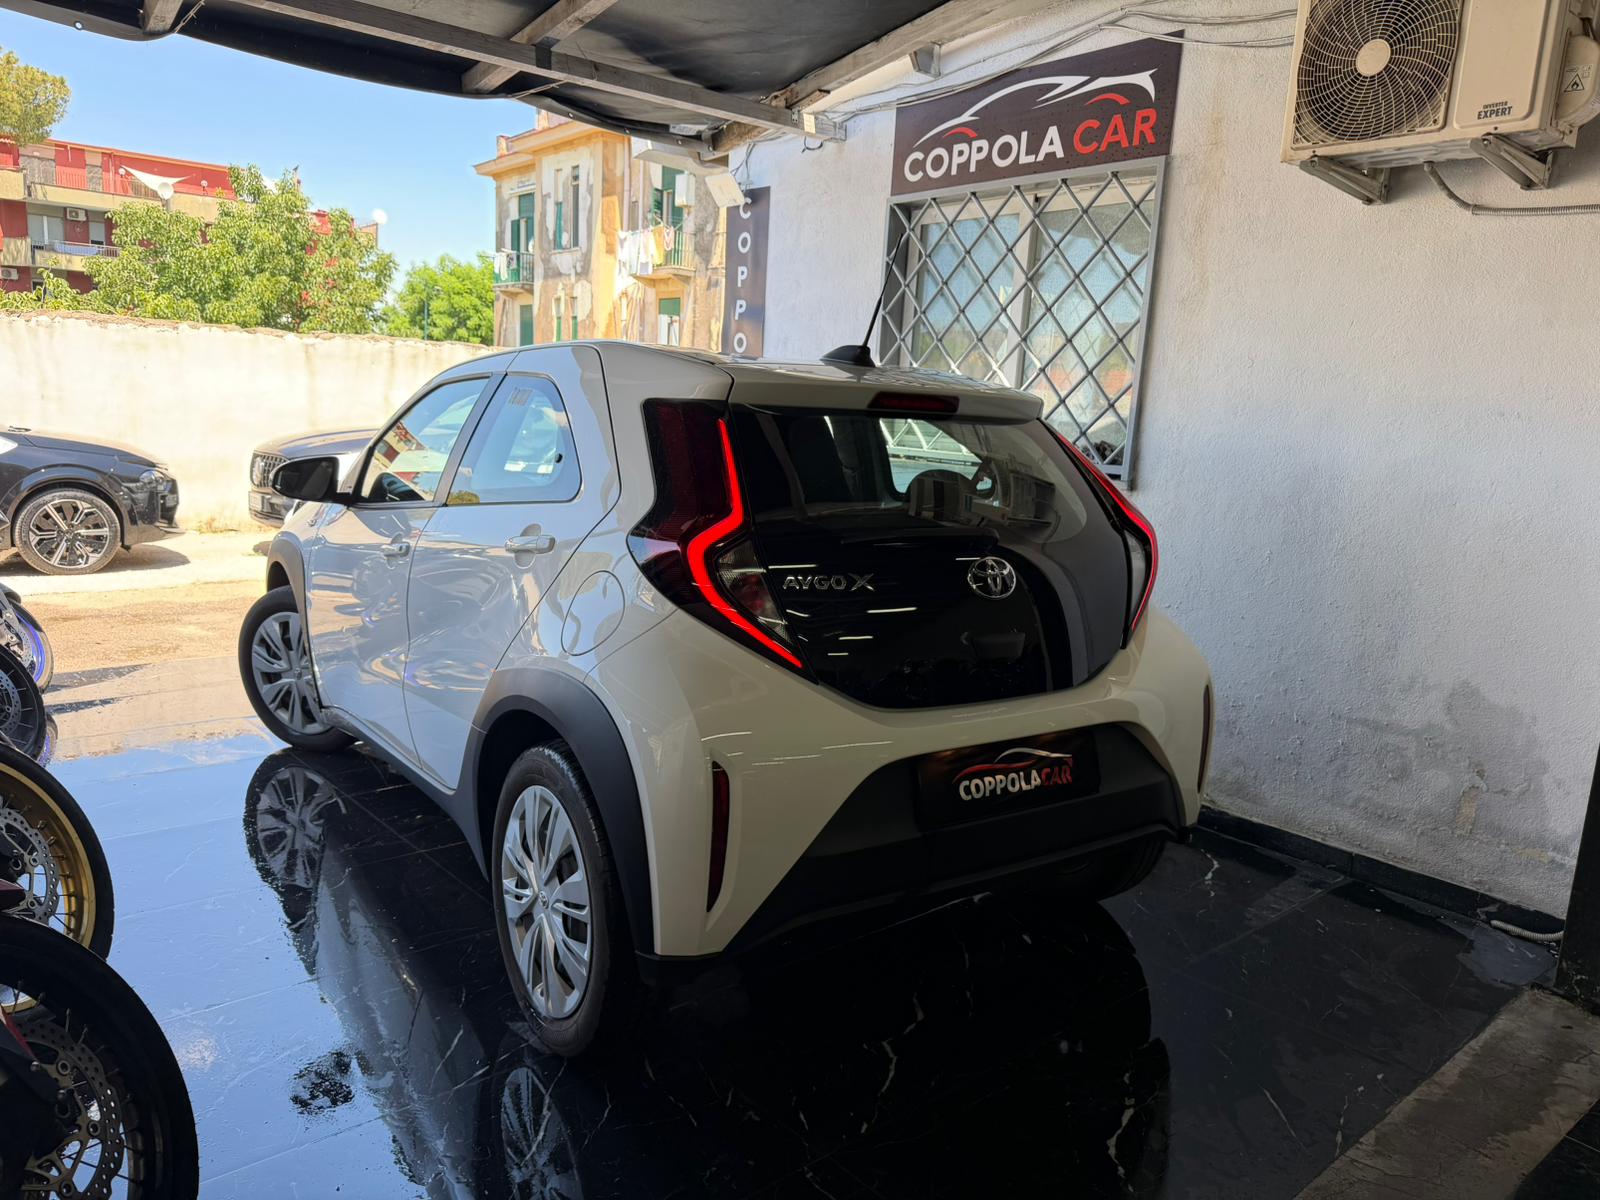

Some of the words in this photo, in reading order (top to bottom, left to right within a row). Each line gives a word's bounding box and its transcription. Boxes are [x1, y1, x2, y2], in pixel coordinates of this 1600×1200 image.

[1477, 106, 1513, 120] EXPERT
[904, 126, 1065, 183] COPPOLA
[1073, 108, 1157, 155] CAR
